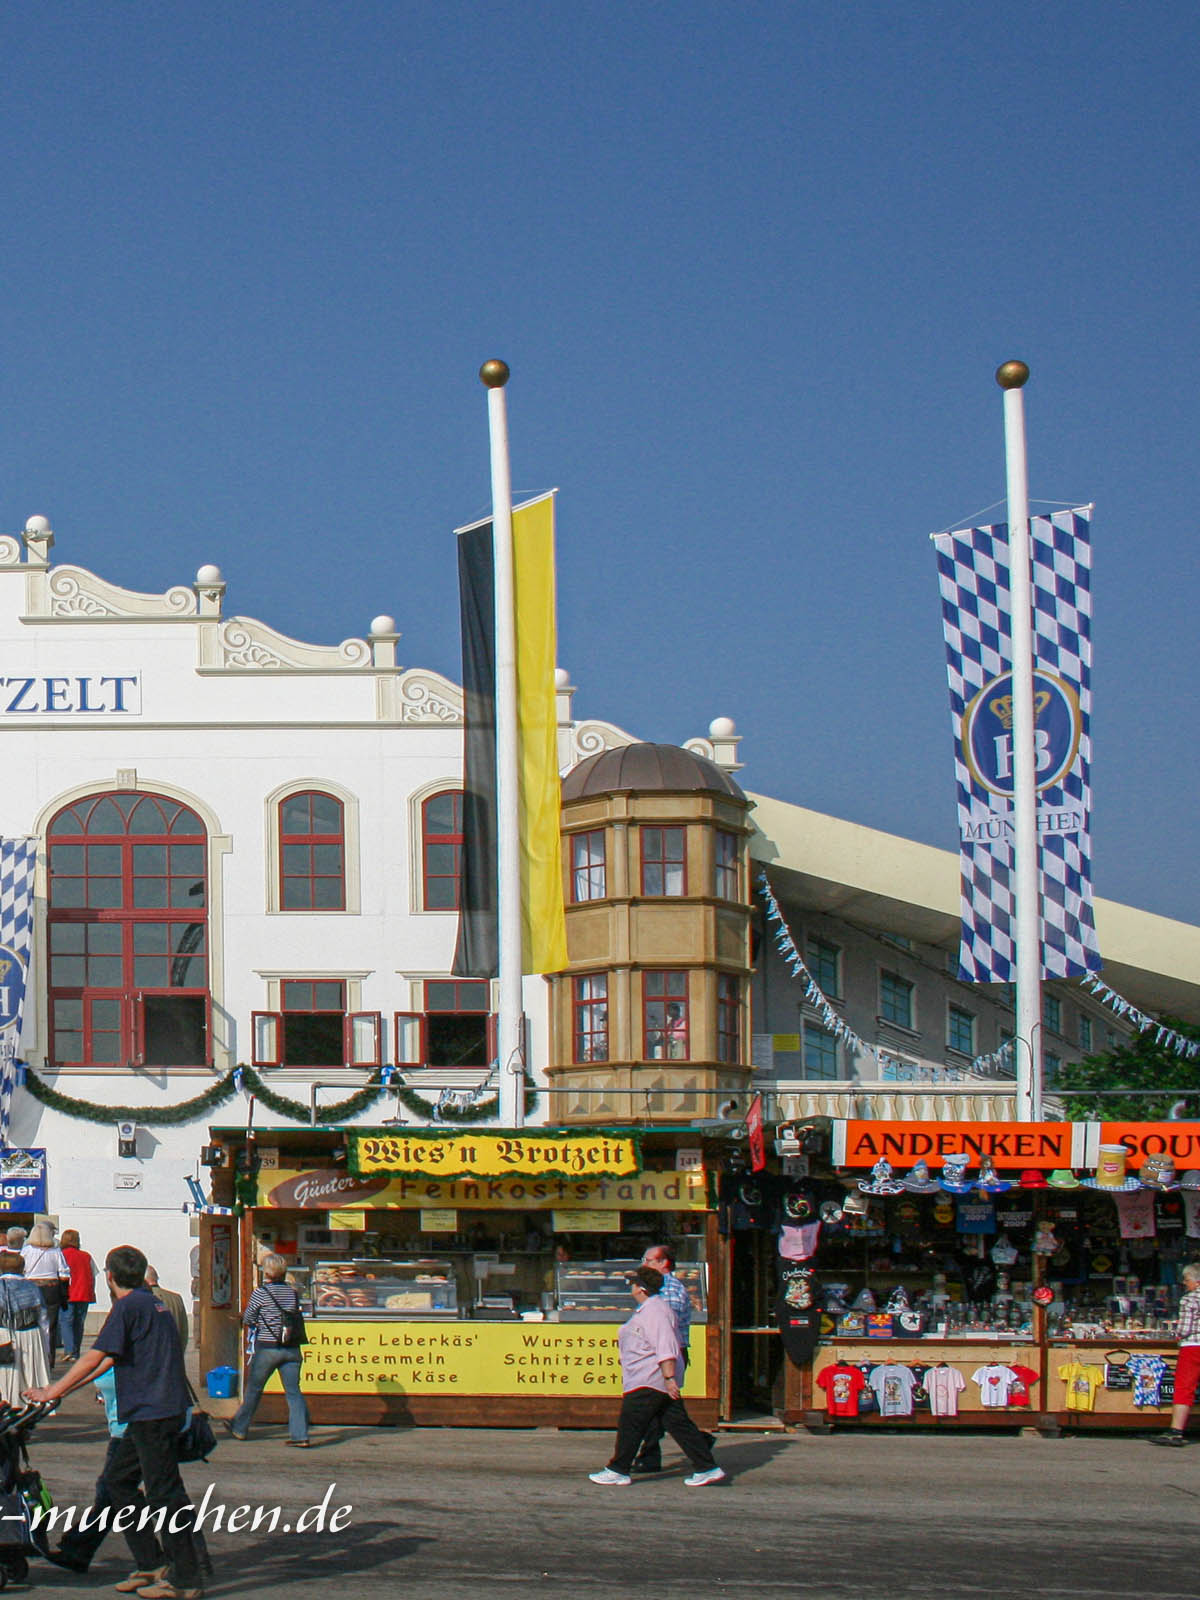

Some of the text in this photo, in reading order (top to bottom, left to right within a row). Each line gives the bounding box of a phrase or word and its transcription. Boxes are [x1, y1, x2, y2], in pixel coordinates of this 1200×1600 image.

[965, 811, 1081, 839] MÜNHEN
[853, 1132, 1063, 1157] ANDENKEN
[364, 1140, 624, 1172] Wies'n Brotzeit
[294, 1177, 353, 1206] Günter
[379, 1334, 479, 1347] Leberkäs'
[303, 1351, 445, 1364] Fischsemmeln
[412, 1371, 458, 1383] Käse
[516, 1371, 569, 1384] kalte
